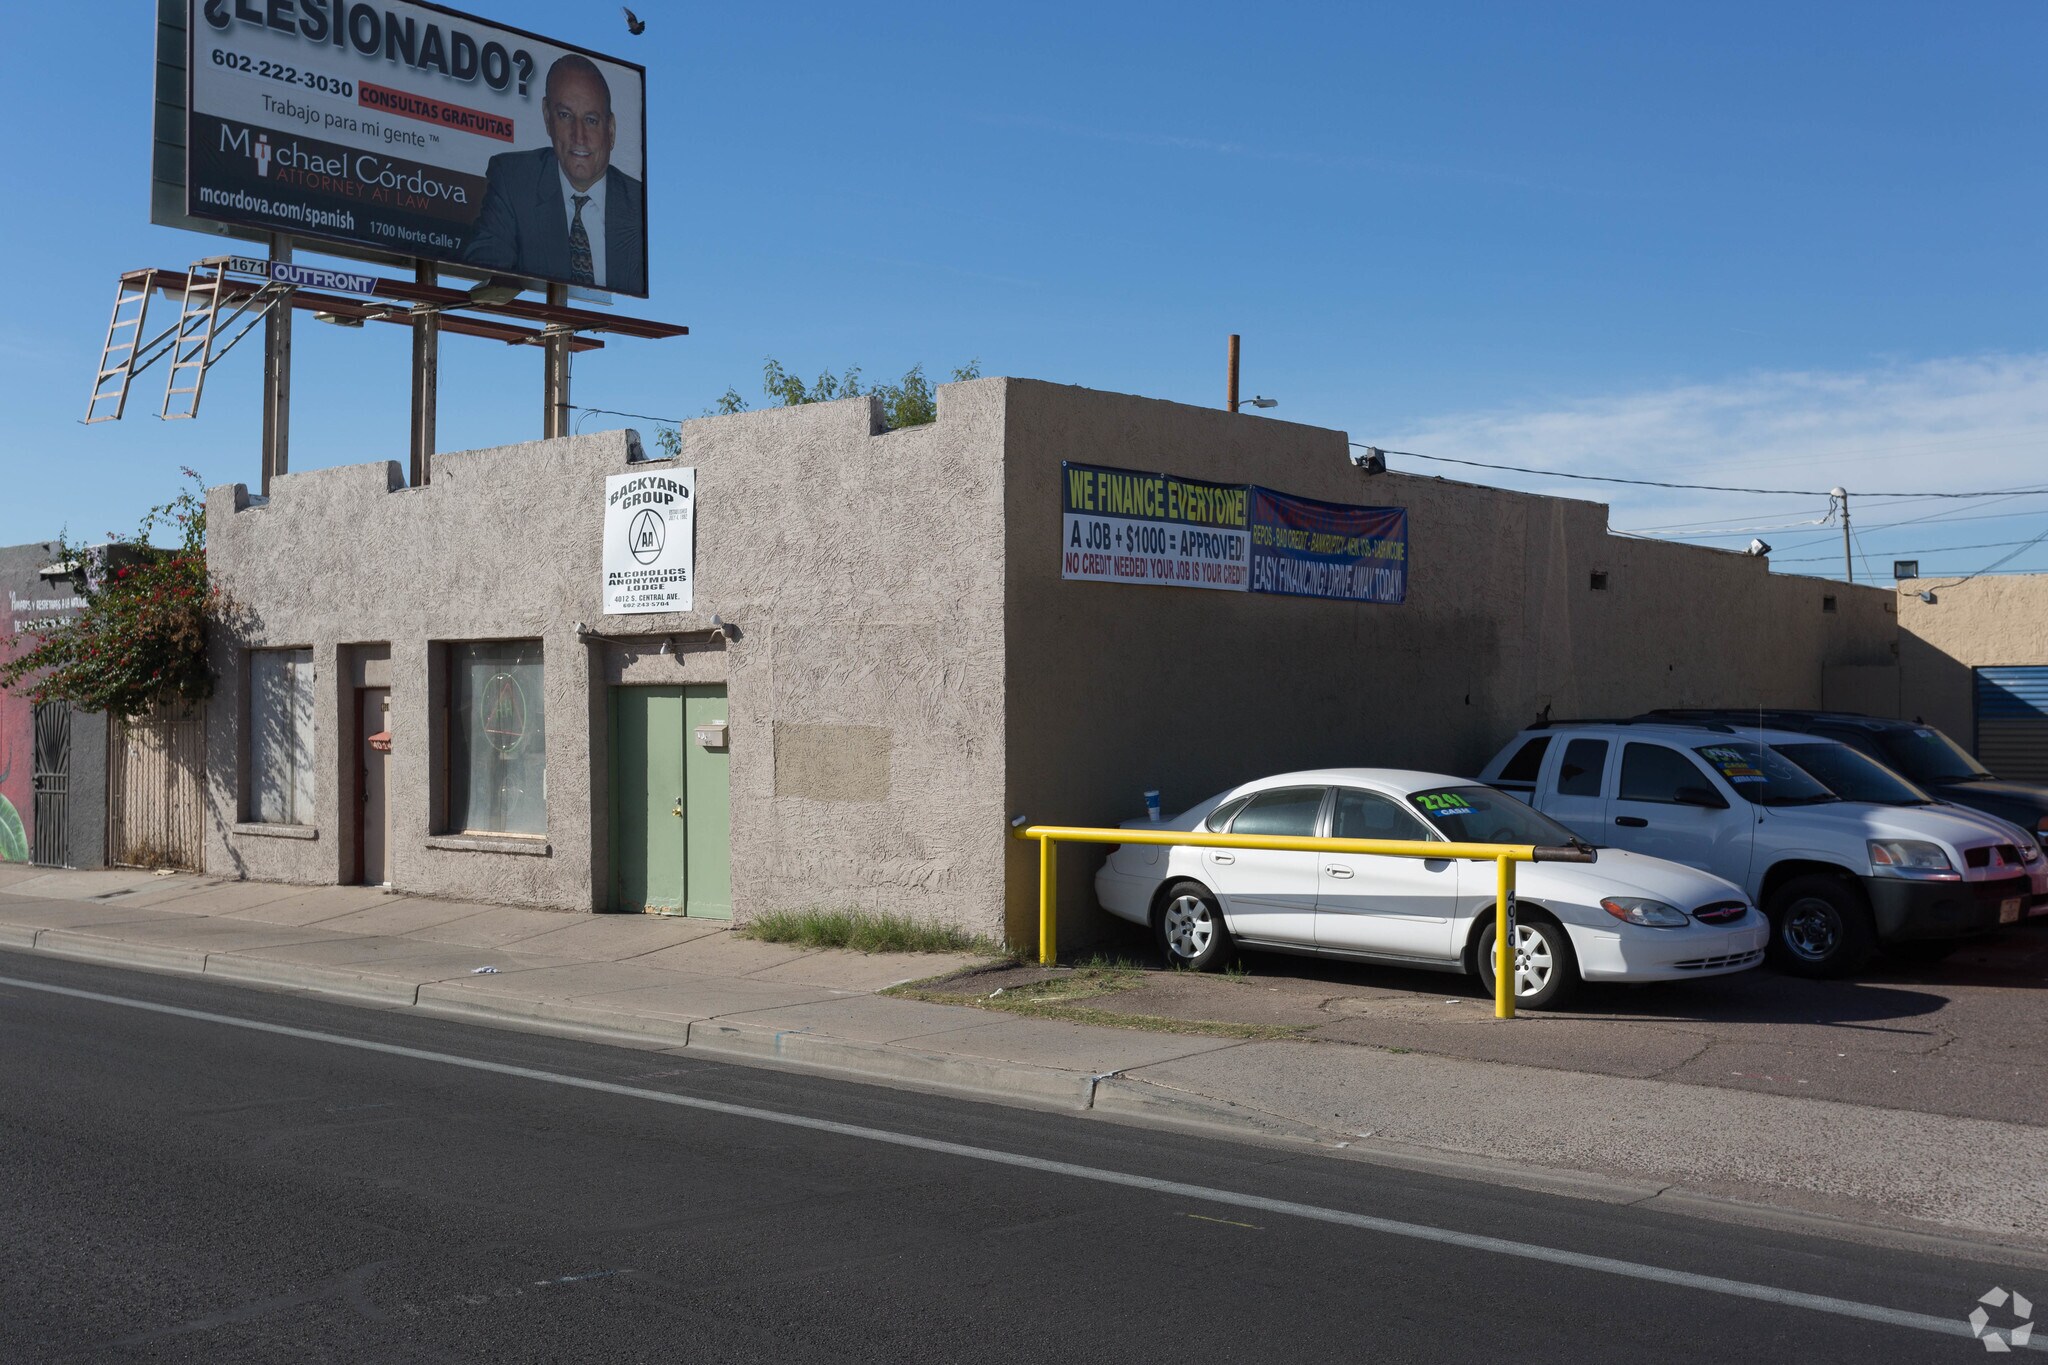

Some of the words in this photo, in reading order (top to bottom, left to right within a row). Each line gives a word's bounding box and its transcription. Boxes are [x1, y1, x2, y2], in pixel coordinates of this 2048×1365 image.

[211, 48, 353, 98] 602-222-3030
[261, 94, 320, 125] Trabajo
[324, 113, 357, 132] para
[361, 121, 380, 137] mi
[383, 128, 426, 148] gente
[360, 86, 438, 119] CONSULTAS
[441, 108, 512, 137] GRATUITAS
[276, 167, 365, 198] ATTORNEY
[372, 187, 390, 202] AT
[396, 191, 430, 210] LAW
[355, 155, 468, 204] Córdova
[200, 186, 355, 231] mcordova.com/spanish
[370, 221, 396, 237] 1700
[397, 226, 427, 244] Norte
[428, 232, 453, 249] Calle
[455, 237, 462, 249] 7
[230, 257, 265, 275] 1671
[274, 264, 372, 292] OUTFRONT
[609, 476, 690, 507] BACKYARD
[622, 491, 674, 511] GROUP
[1068, 469, 1094, 511] WE
[1097, 473, 1165, 518] FINANCE
[1167, 481, 1247, 527] EVERYONE!
[641, 531, 654, 548] AA
[1070, 520, 1082, 548] A
[1086, 522, 1112, 551] JOB
[1126, 523, 1166, 556] $1000
[1180, 530, 1246, 562] APPROVED!
[1253, 524, 1273, 547] REPOS
[1276, 527, 1288, 549] BAD
[1288, 529, 1309, 551] CREDIT
[1310, 532, 1345, 555] BANKRUPTCY
[608, 567, 686, 579] ALCOHOLICS
[608, 575, 687, 586] ANONYMOUS
[1065, 552, 1080, 574] NO
[1082, 552, 1112, 576] CREDIT
[1114, 556, 1149, 578] NEEDED!
[1150, 558, 1175, 580] YOUR
[1176, 560, 1191, 581] JOB
[1192, 561, 1200, 582] IS
[1201, 562, 1222, 584] YOUR
[1223, 564, 1248, 586] CREDIT!
[1253, 555, 1279, 592] EASY
[1279, 557, 1328, 596] FINANCING!
[1327, 563, 1352, 598] DRIVE
[1351, 565, 1374, 600] AWAY
[1374, 567, 1403, 602] TODAY!
[614, 594, 630, 603] 4012
[638, 593, 664, 601] CENTRAL
[666, 592, 680, 601] AVE.
[627, 583, 666, 592] LODGE
[1440, 808, 1472, 816] CASH
[1508, 890, 1516, 947] 4010
